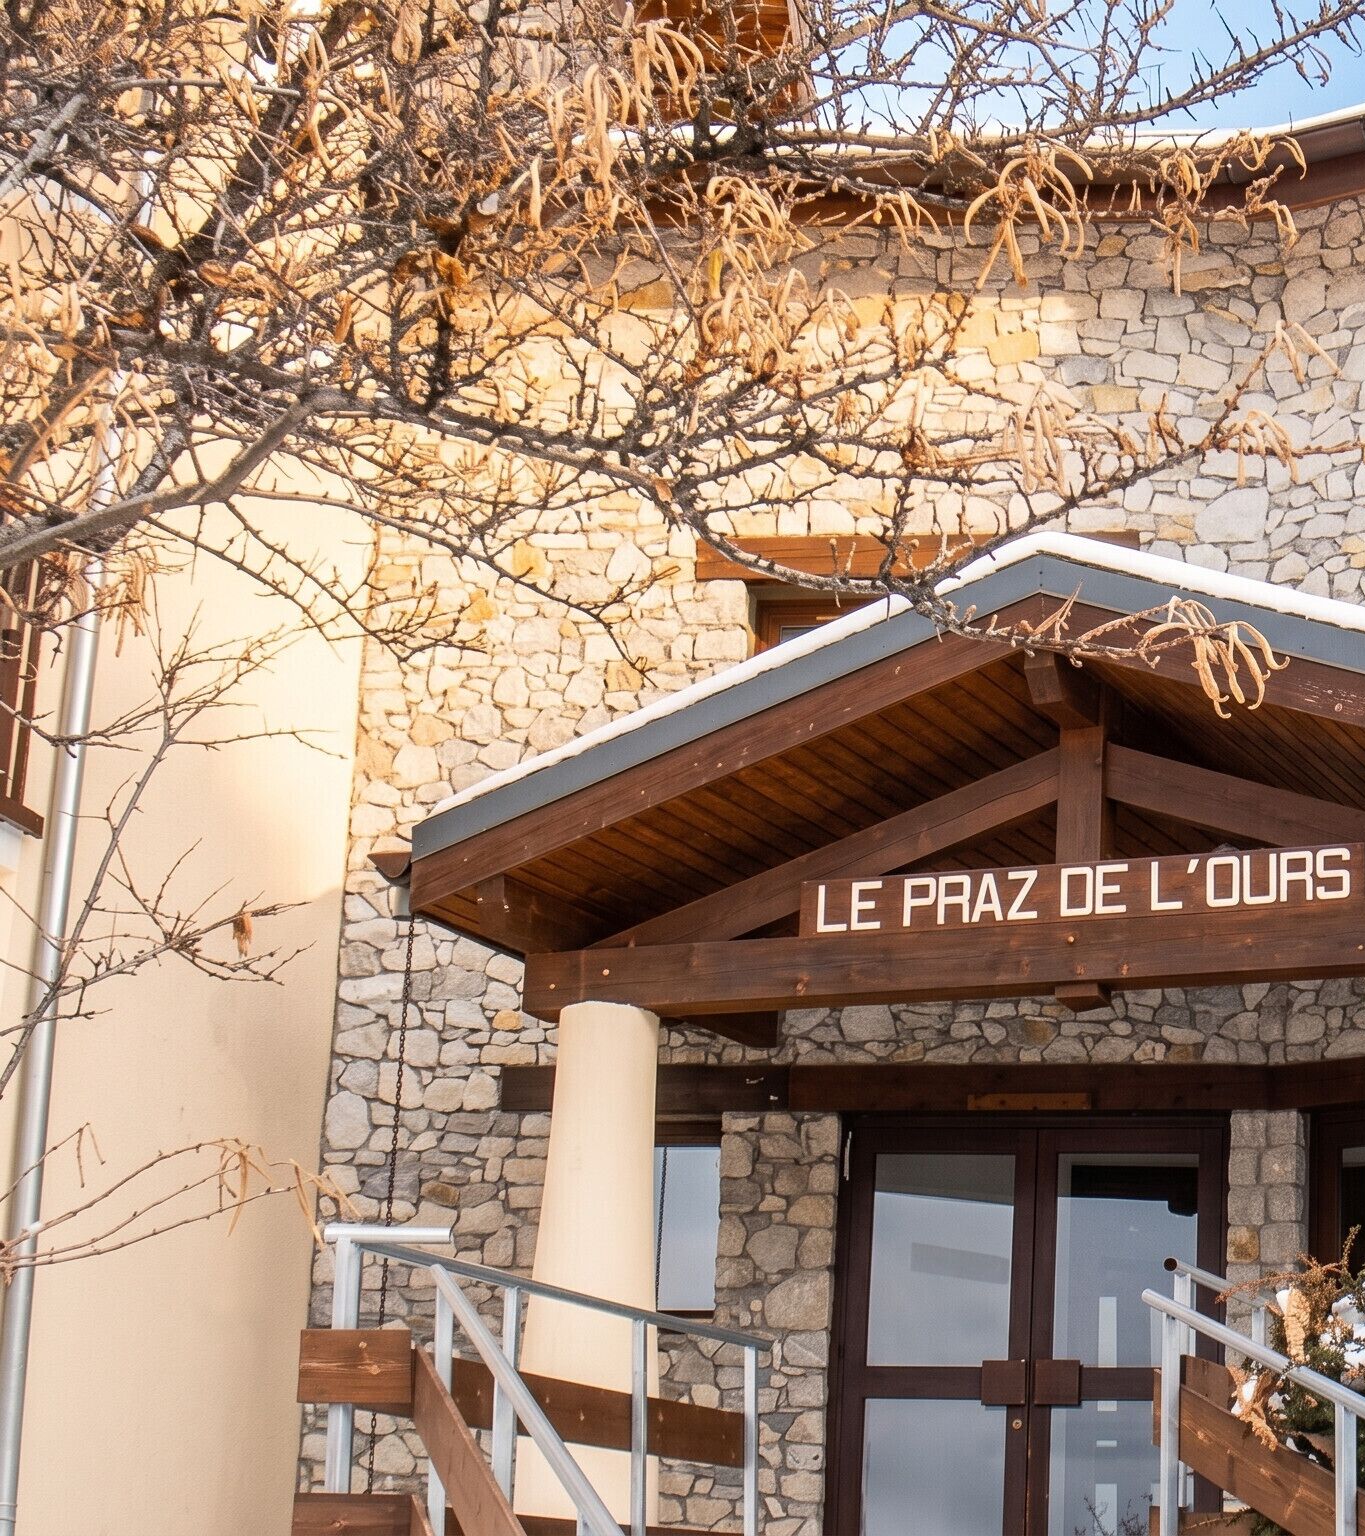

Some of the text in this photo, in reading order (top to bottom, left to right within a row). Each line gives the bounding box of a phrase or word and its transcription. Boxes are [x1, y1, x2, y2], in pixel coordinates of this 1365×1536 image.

[816, 881, 883, 933] LE
[903, 869, 1038, 927] PRAZ
[1060, 863, 1129, 917] DE
